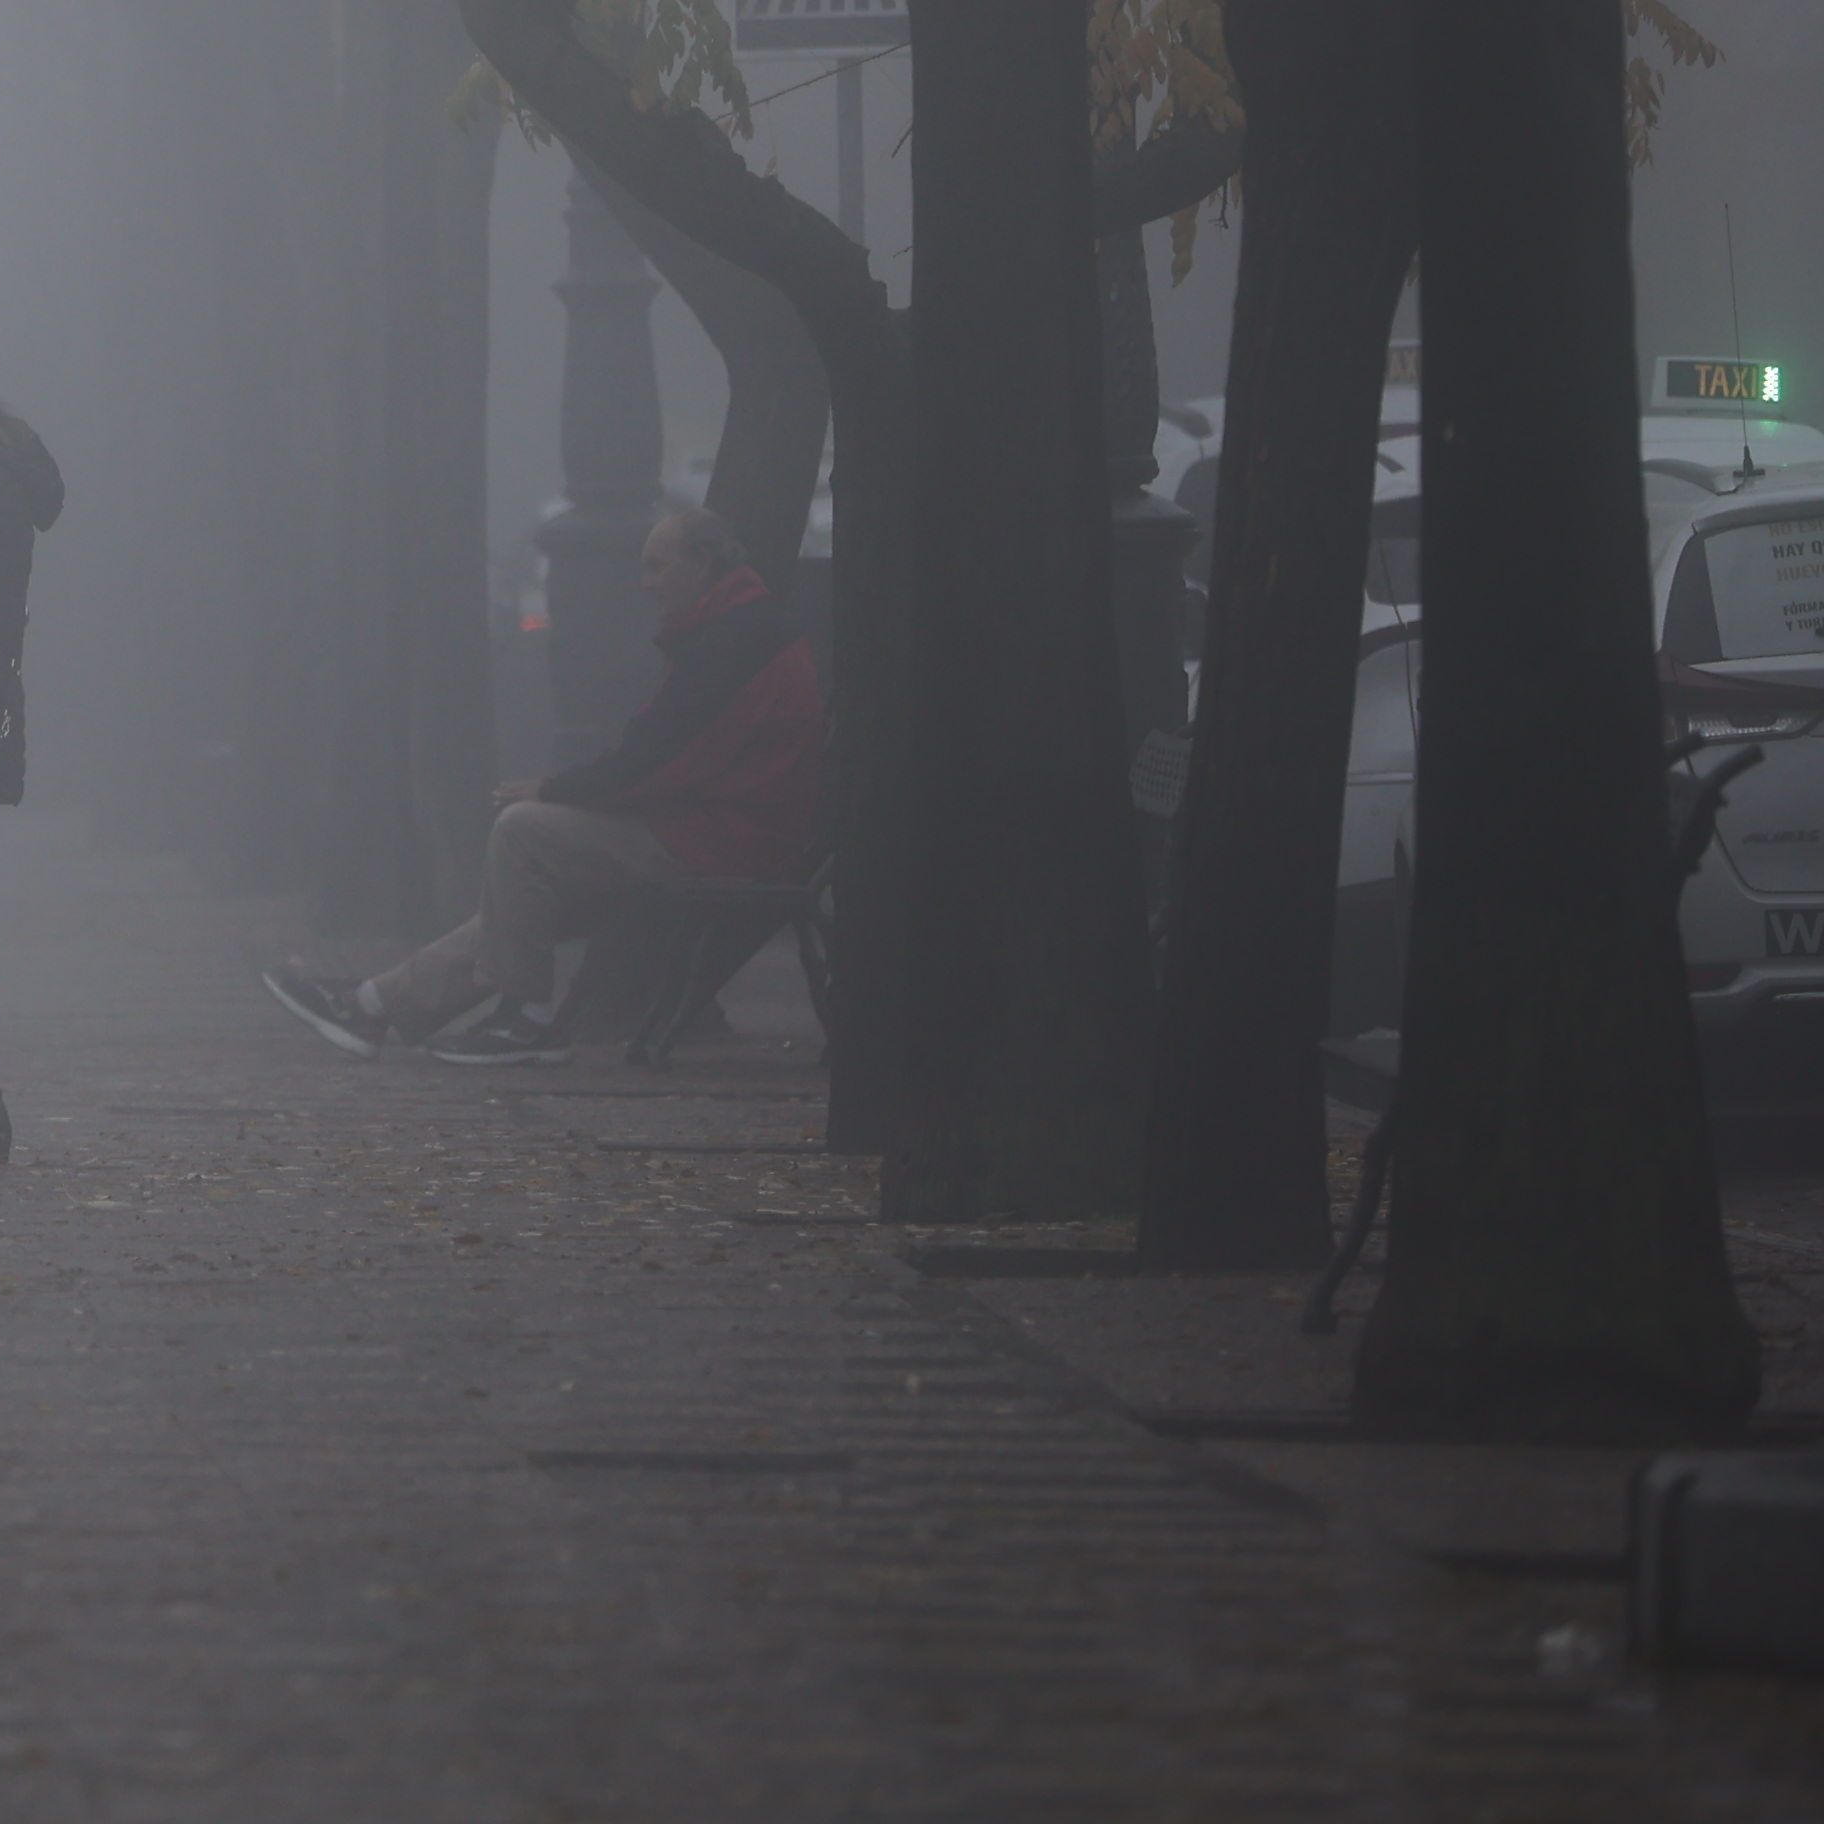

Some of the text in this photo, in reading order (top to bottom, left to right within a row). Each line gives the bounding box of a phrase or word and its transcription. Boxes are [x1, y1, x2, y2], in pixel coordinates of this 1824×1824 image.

[1694, 364, 1758, 398] TAXI
[1772, 543, 1805, 559] HAY
[1777, 564, 1824, 581] HUEV
